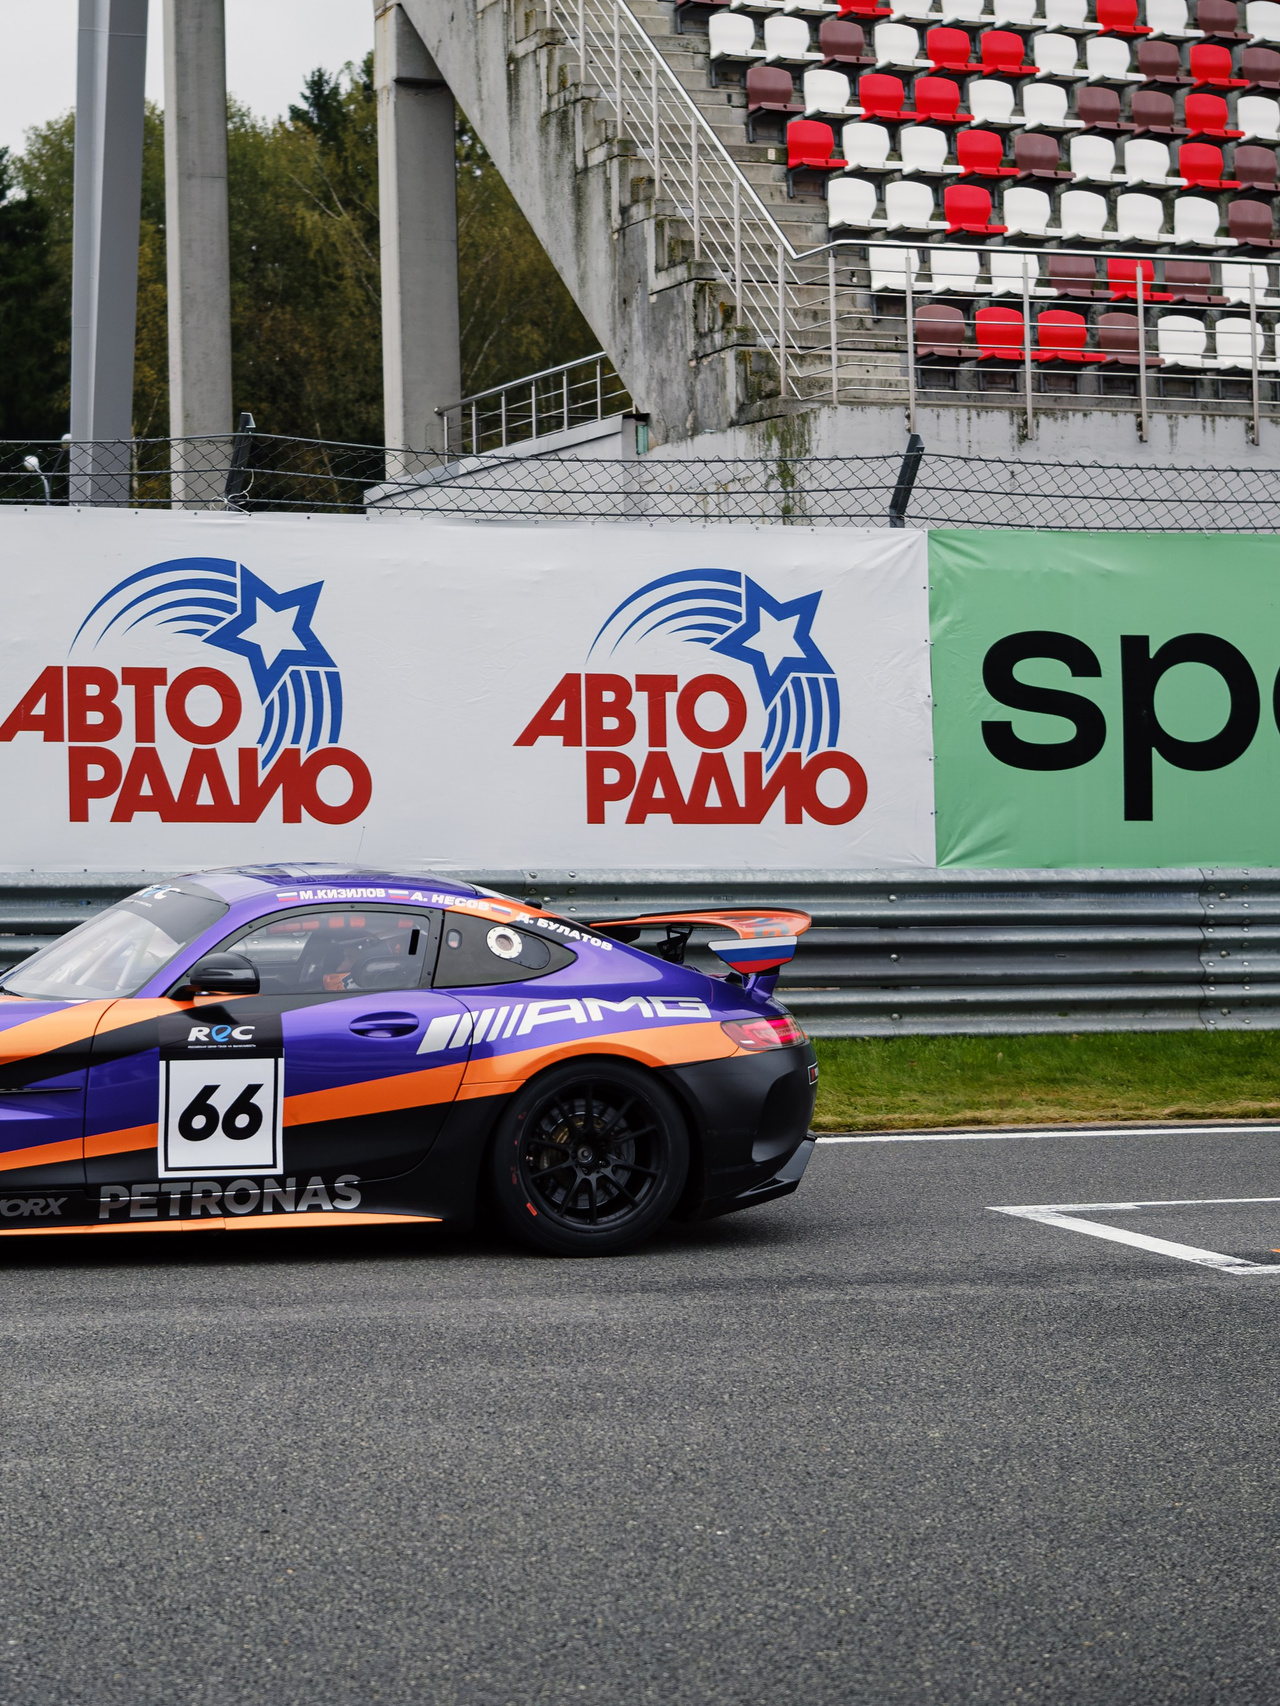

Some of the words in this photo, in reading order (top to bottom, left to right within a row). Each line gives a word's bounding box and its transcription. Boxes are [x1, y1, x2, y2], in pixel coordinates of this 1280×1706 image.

[514, 673, 748, 750] АВТО
[981, 630, 1280, 821] sp
[69, 746, 373, 825] РАДИО
[586, 750, 868, 826] РАДИО
[431, 893, 492, 911] НЕСОВ
[536, 917, 613, 951] БУЛАТОВ
[178, 1083, 265, 1142] 66
[98, 1174, 362, 1219] PETRONAS
